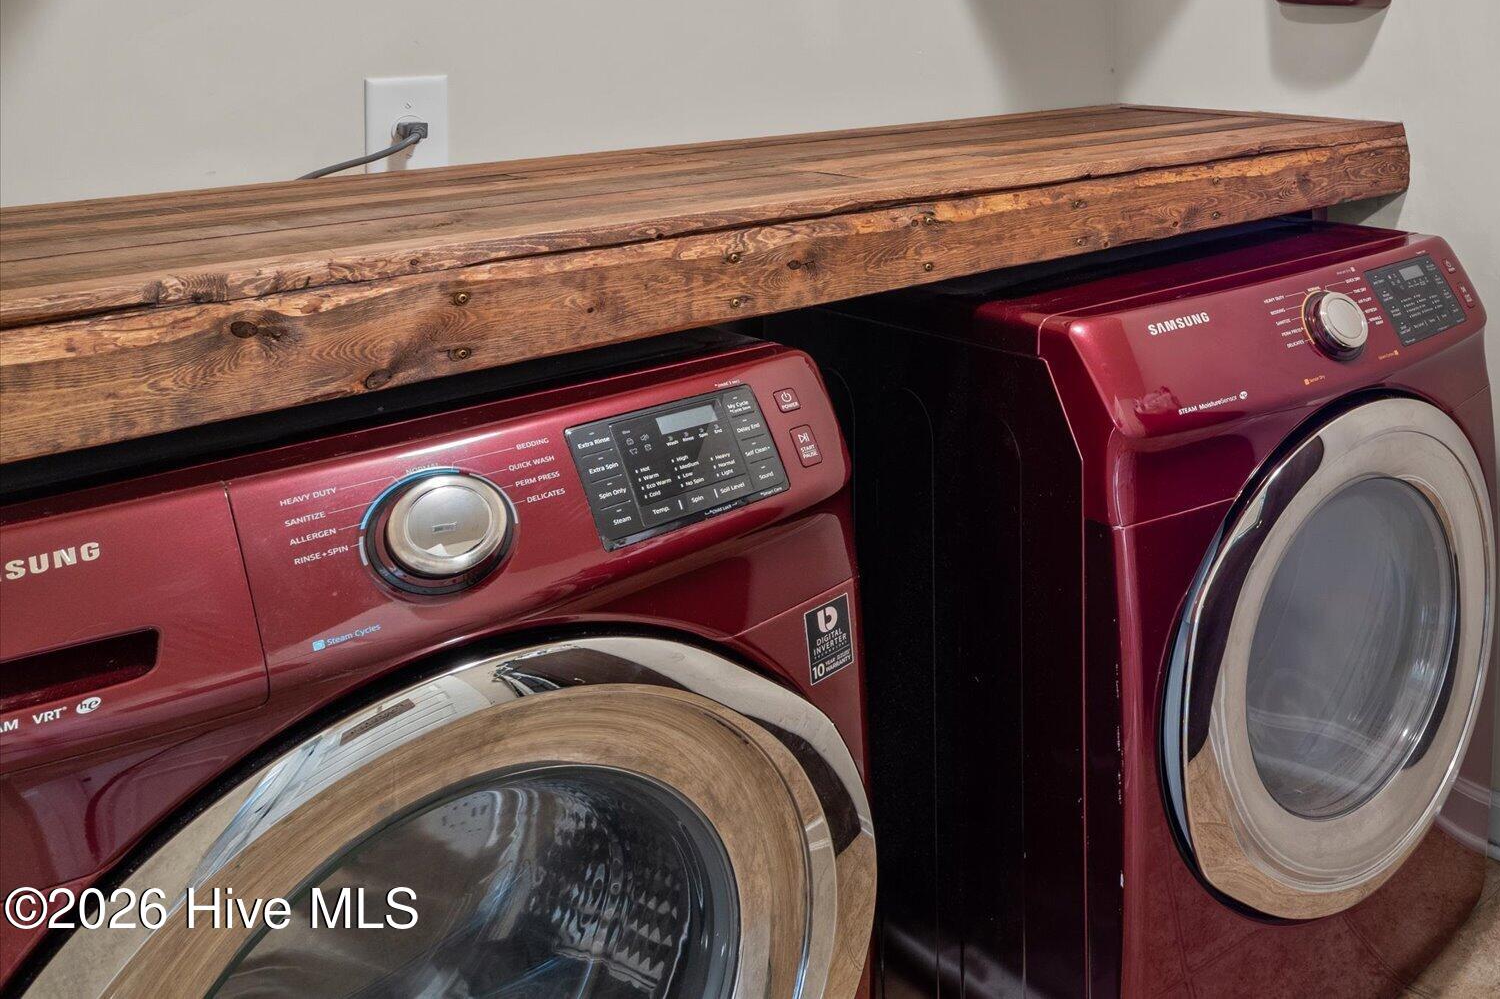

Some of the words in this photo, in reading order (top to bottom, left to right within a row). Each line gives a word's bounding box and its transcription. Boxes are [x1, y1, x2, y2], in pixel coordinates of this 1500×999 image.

[1147, 311, 1211, 337] SAMSUNG
[516, 437, 549, 450] BEDDING
[577, 441, 594, 449] Extra
[508, 461, 532, 471] QUICK
[532, 455, 555, 465] WASH
[588, 466, 606, 475] Extra
[605, 461, 619, 470] Spin
[515, 477, 537, 488] PERM
[537, 471, 560, 482] PRESS
[279, 493, 311, 507] HEAVY
[312, 487, 337, 498] DUTY
[526, 487, 567, 503] DELICATES
[598, 491, 612, 500] Spin
[612, 487, 627, 497] Only
[691, 494, 705, 503] Spin
[284, 511, 326, 527] SANITIZE
[613, 515, 632, 525] Steam
[289, 527, 337, 546] ALLERGEN
[0, 542, 100, 582] SUNG
[326, 633, 353, 646] Steam
[354, 624, 381, 636] Cycles
[816, 627, 843, 646] DIGITAL
[813, 633, 847, 657] INVERTER
[812, 662, 826, 680] 10
